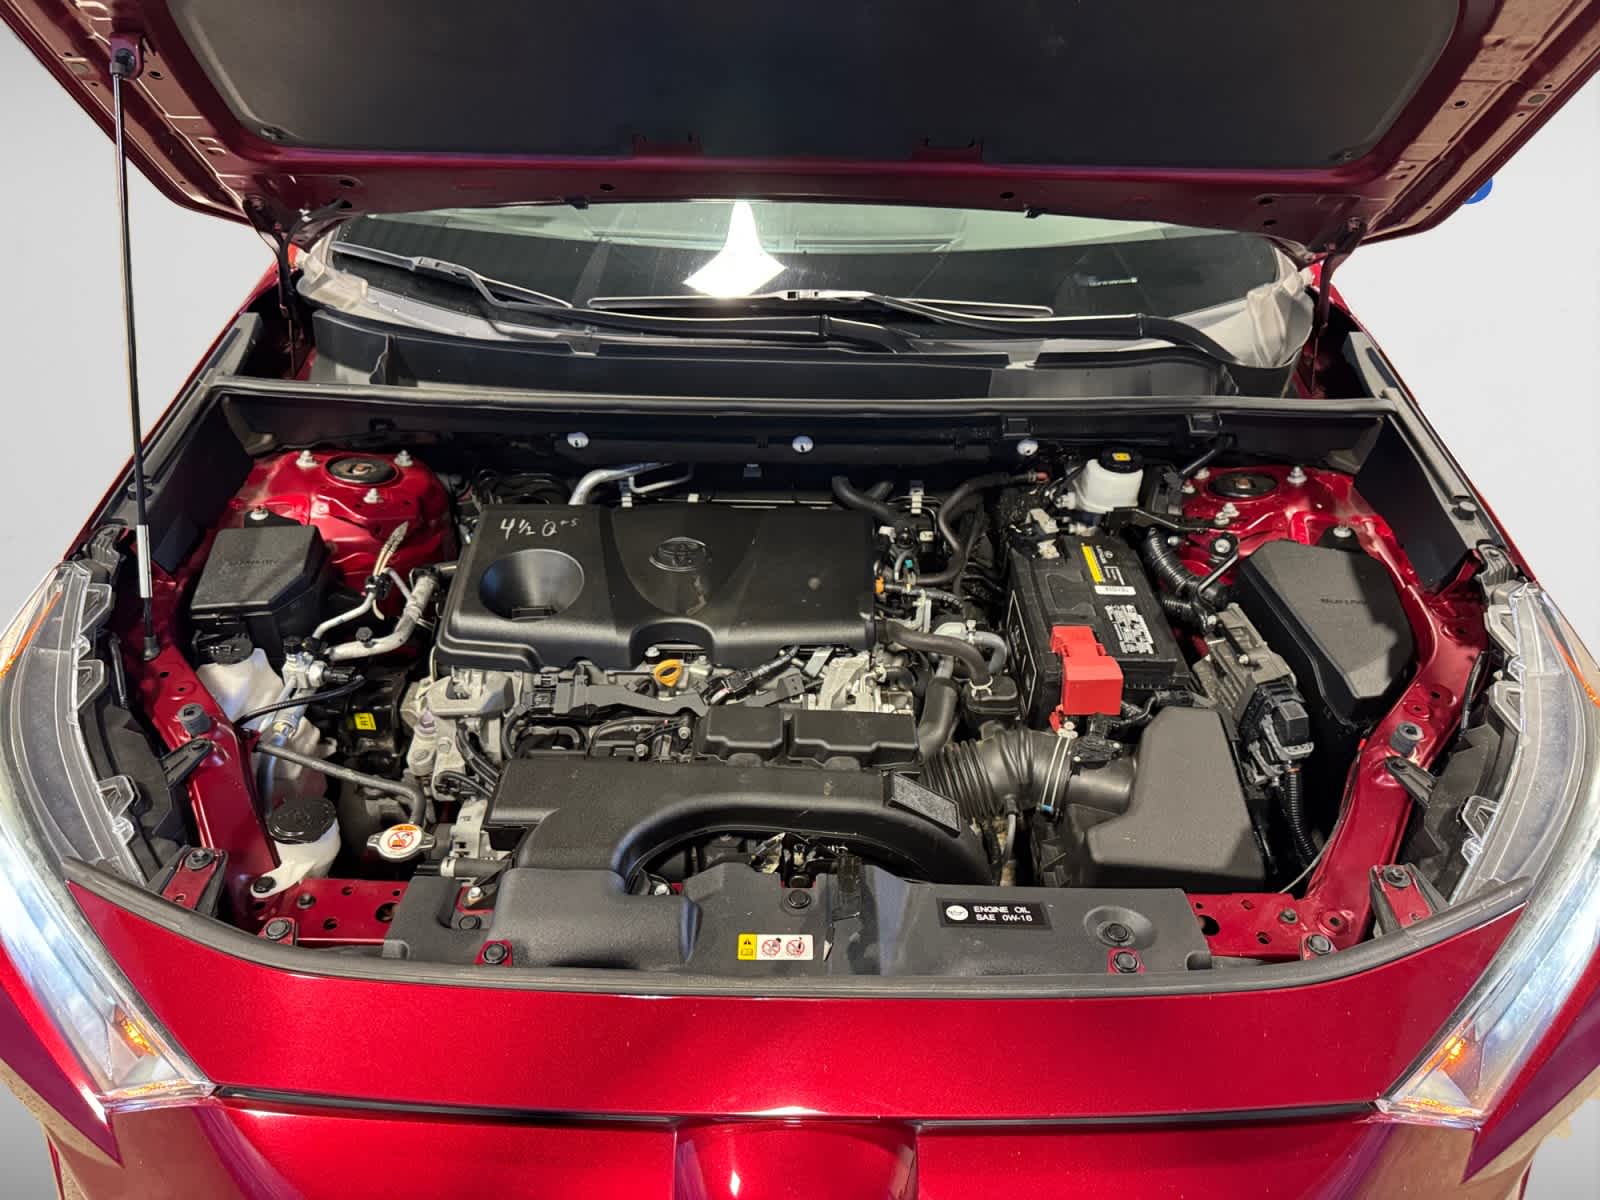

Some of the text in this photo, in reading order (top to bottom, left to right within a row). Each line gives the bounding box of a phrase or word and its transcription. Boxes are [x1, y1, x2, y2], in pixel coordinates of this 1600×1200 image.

[973, 905, 1031, 914] ENGINE OIL
[975, 913, 1033, 922] SAE 0W-16
